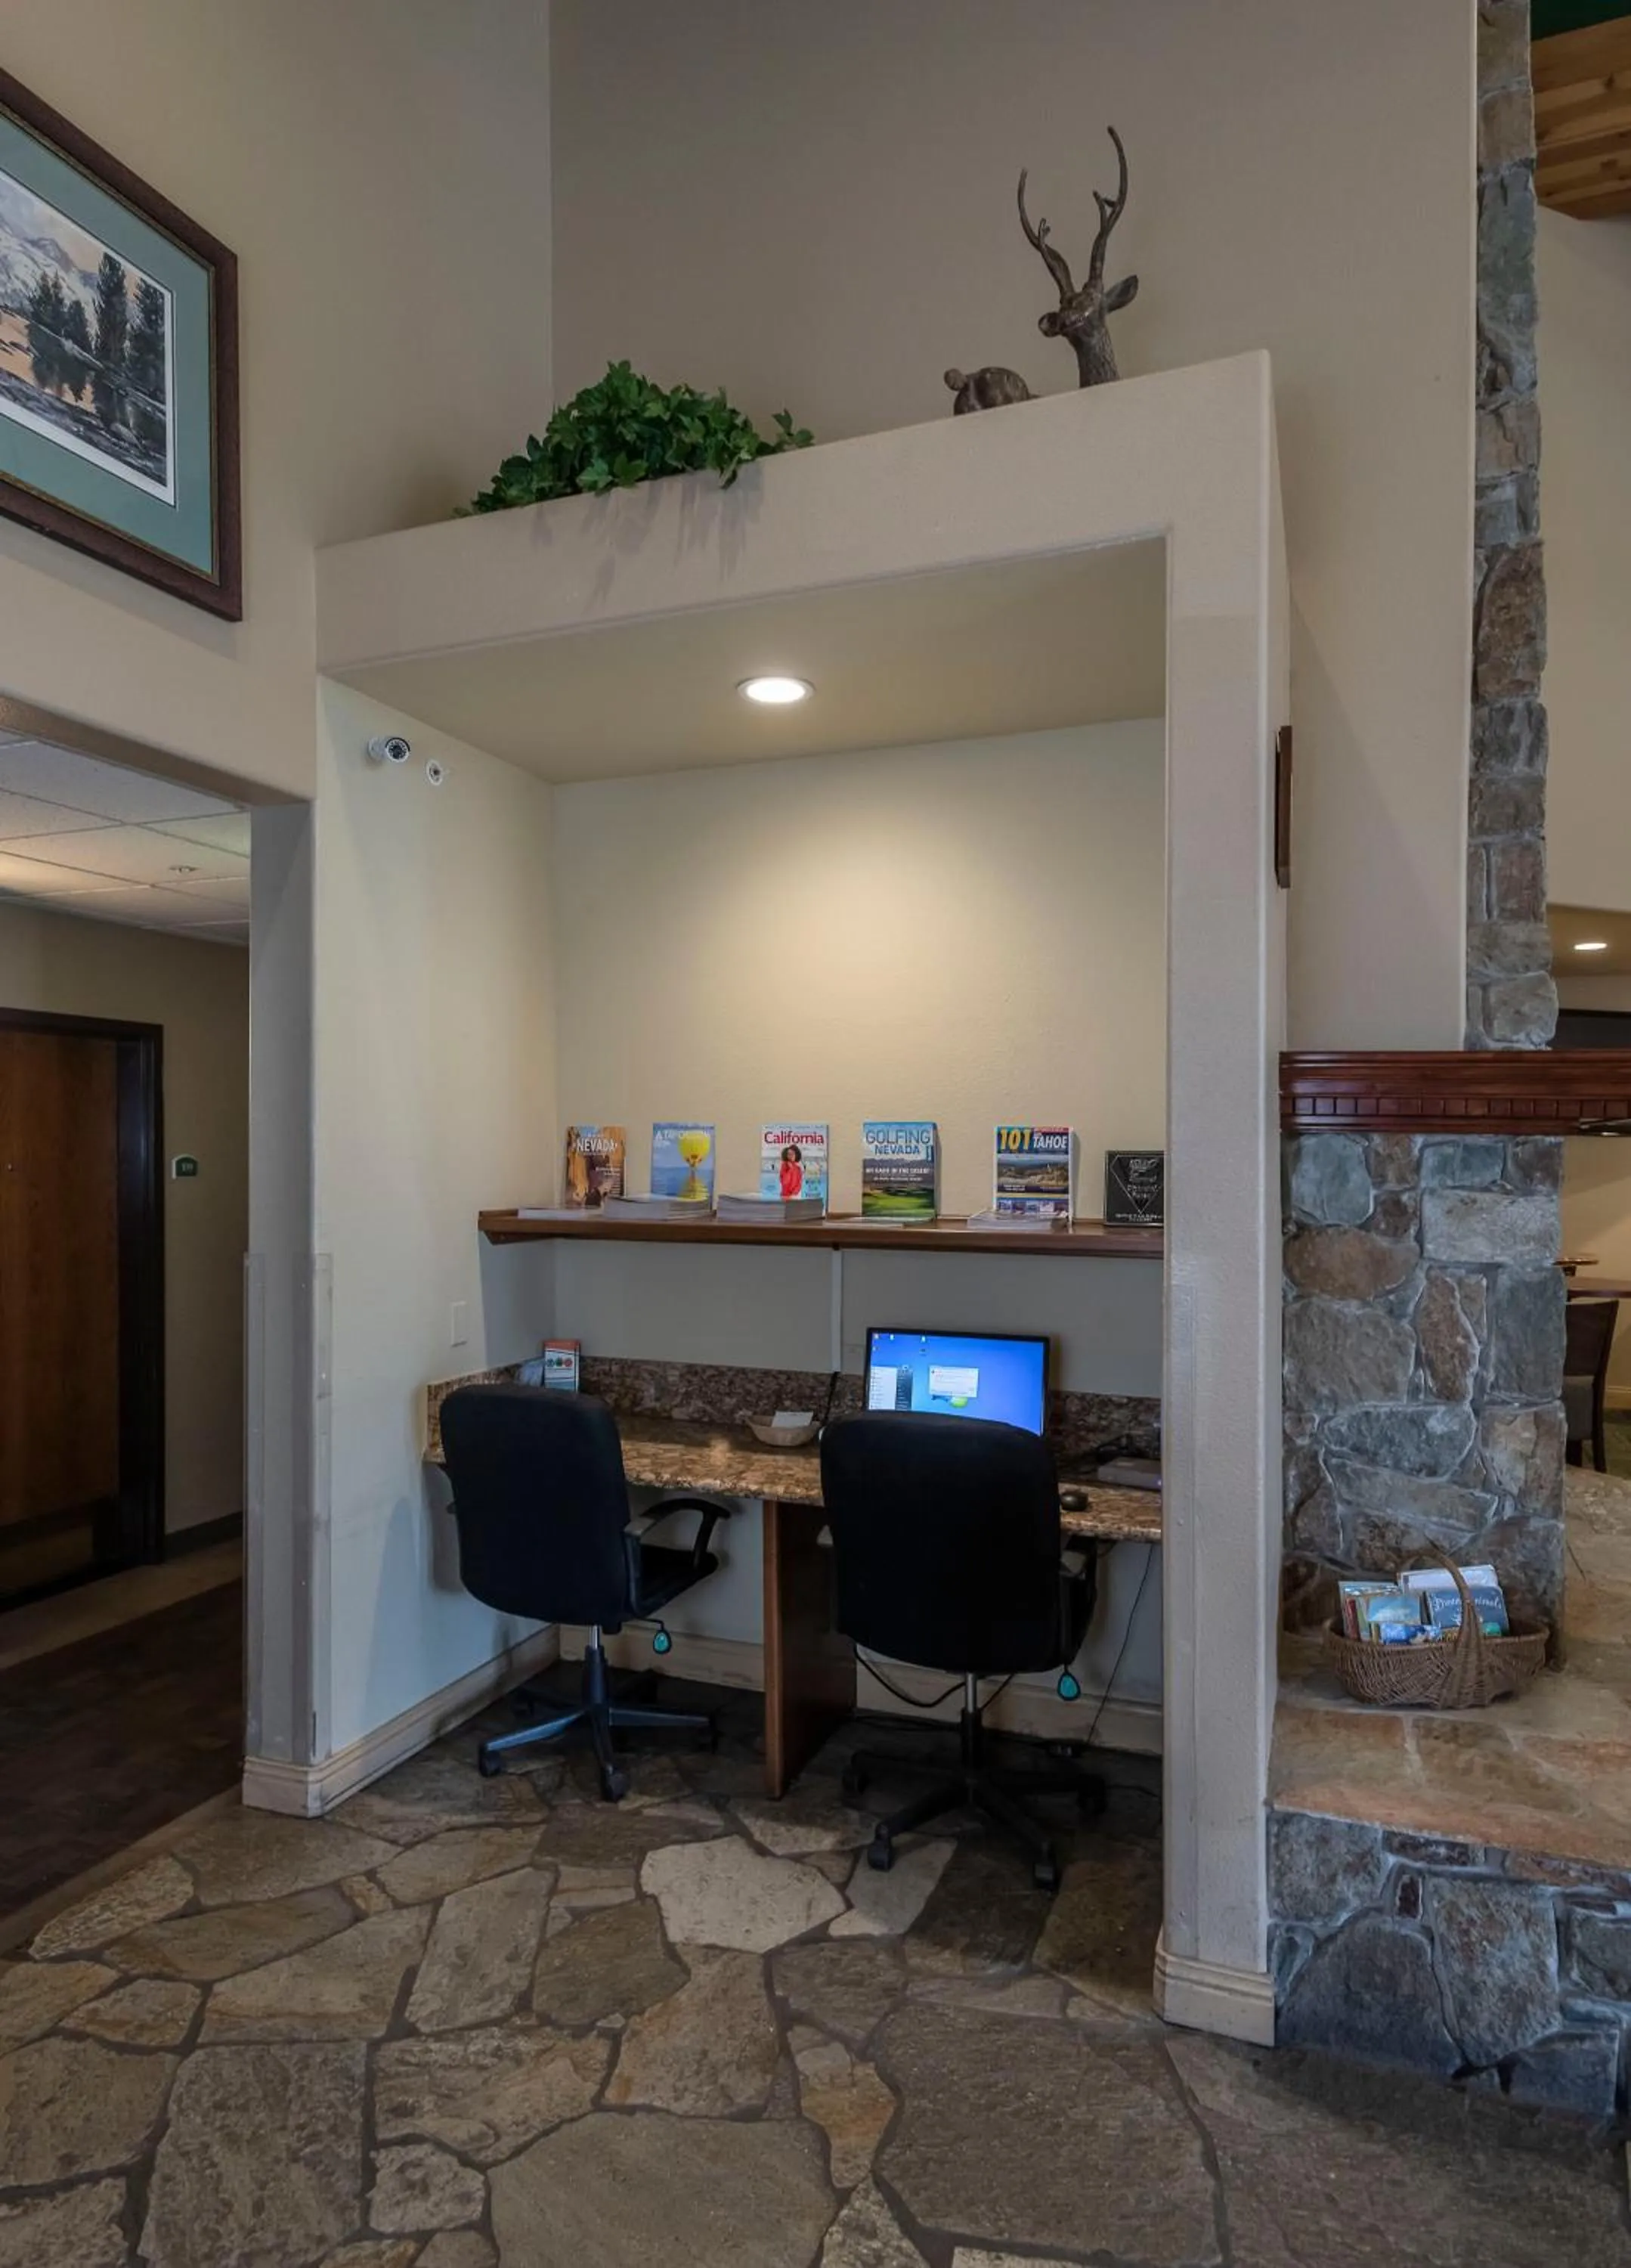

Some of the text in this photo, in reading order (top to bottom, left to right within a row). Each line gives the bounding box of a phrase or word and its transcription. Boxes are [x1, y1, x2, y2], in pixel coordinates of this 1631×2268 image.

[764, 1131, 825, 1144] California
[866, 1129, 930, 1144] GOLFING
[1000, 1129, 1068, 1150] 101 TAHOE
[577, 1139, 614, 1151] NEVADA
[875, 1145, 920, 1154] NEVADA
